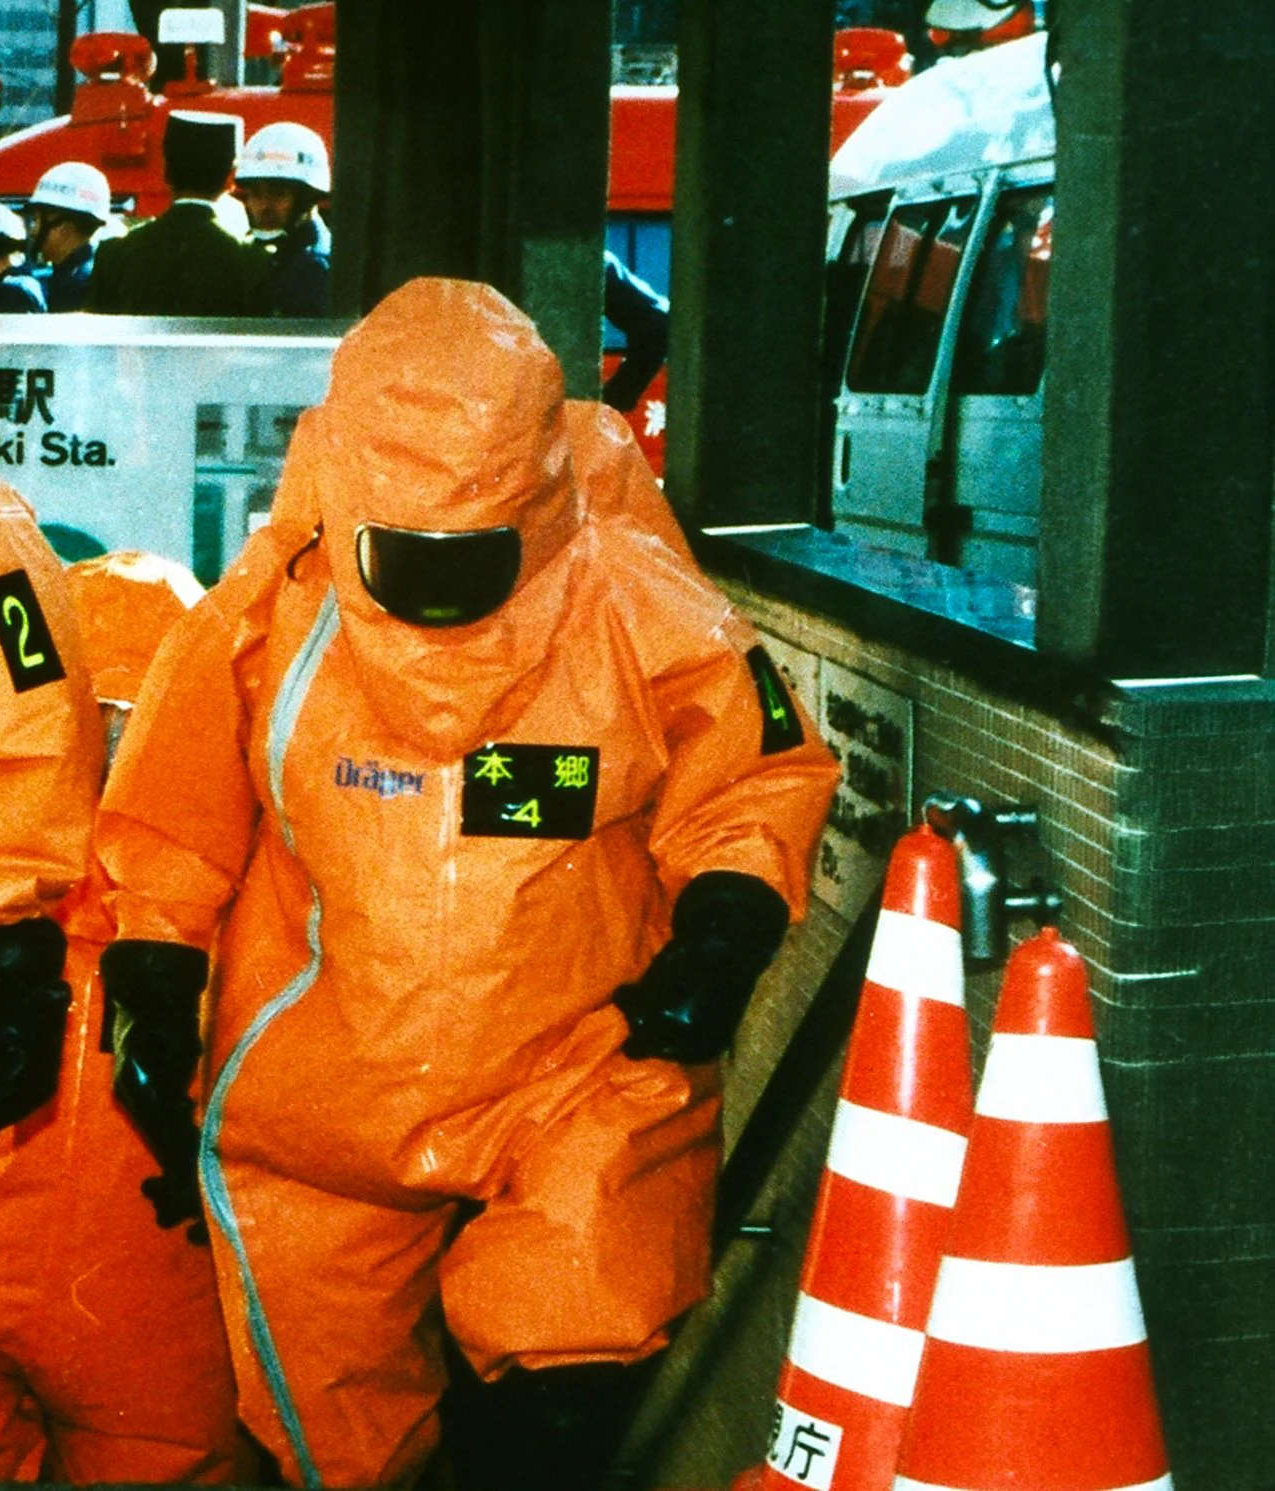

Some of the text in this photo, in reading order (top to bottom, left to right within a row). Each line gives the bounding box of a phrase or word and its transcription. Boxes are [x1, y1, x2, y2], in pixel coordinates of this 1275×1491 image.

[40, 431, 116, 466] Sta.
[2, 595, 45, 668] 2
[511, 799, 542, 828] 4
